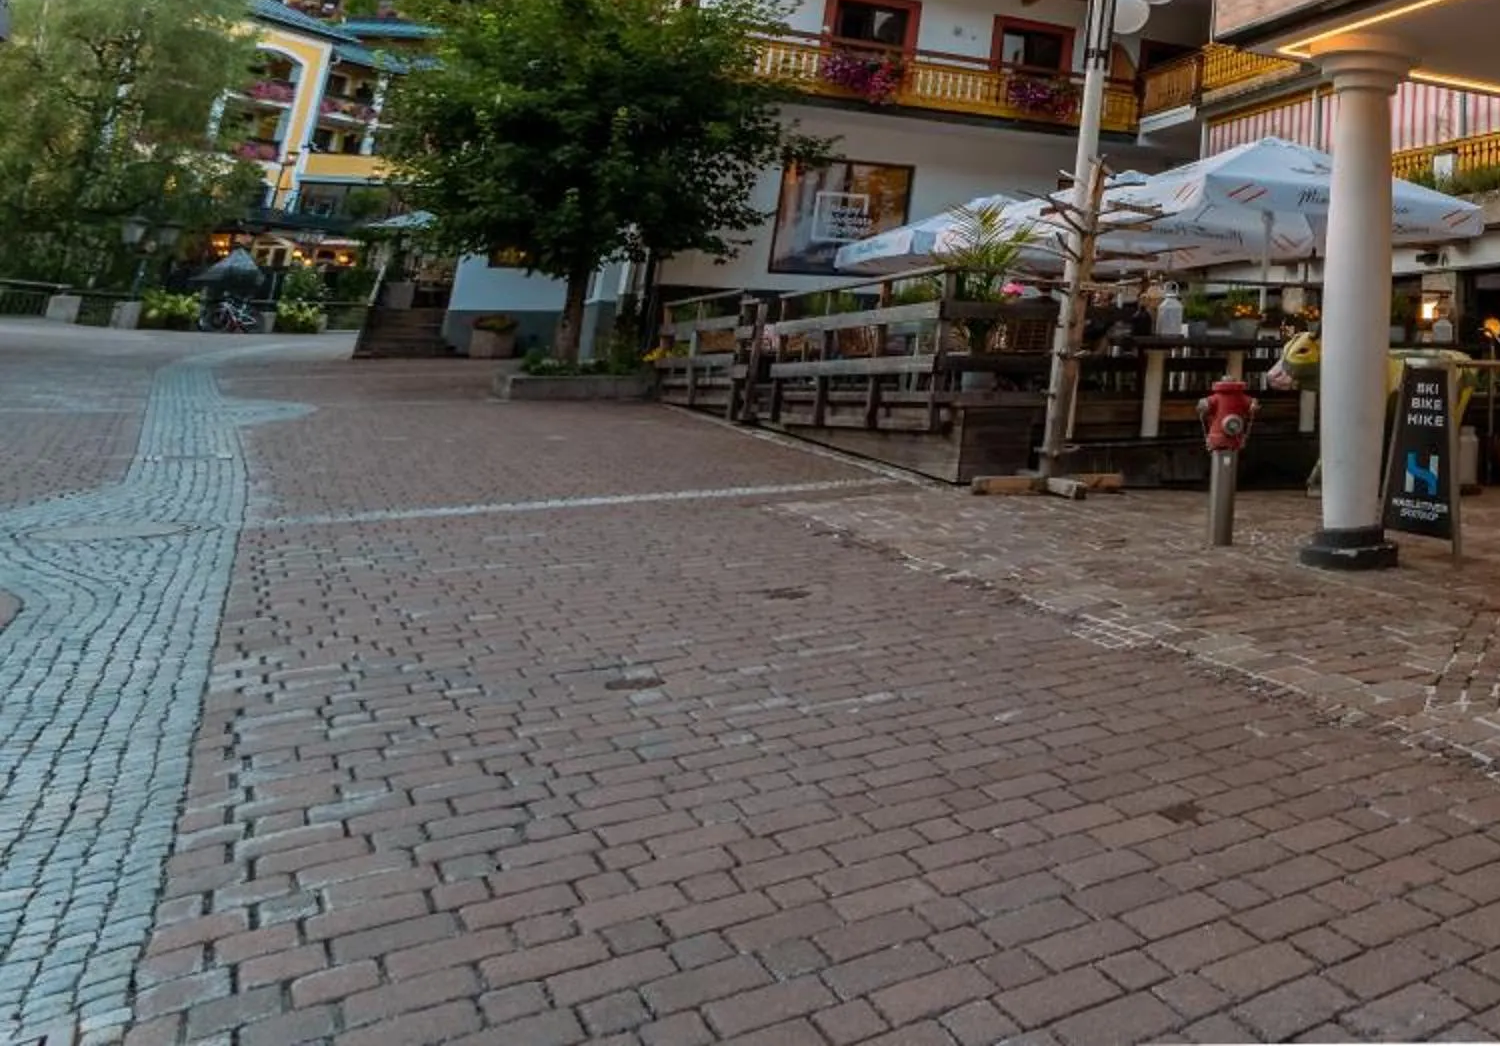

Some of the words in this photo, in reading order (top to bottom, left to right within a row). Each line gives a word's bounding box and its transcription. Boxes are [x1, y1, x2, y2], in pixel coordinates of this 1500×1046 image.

[1416, 382, 1439, 395] SKI
[1411, 397, 1442, 411] BIKE
[1407, 413, 1444, 427] HIKE
